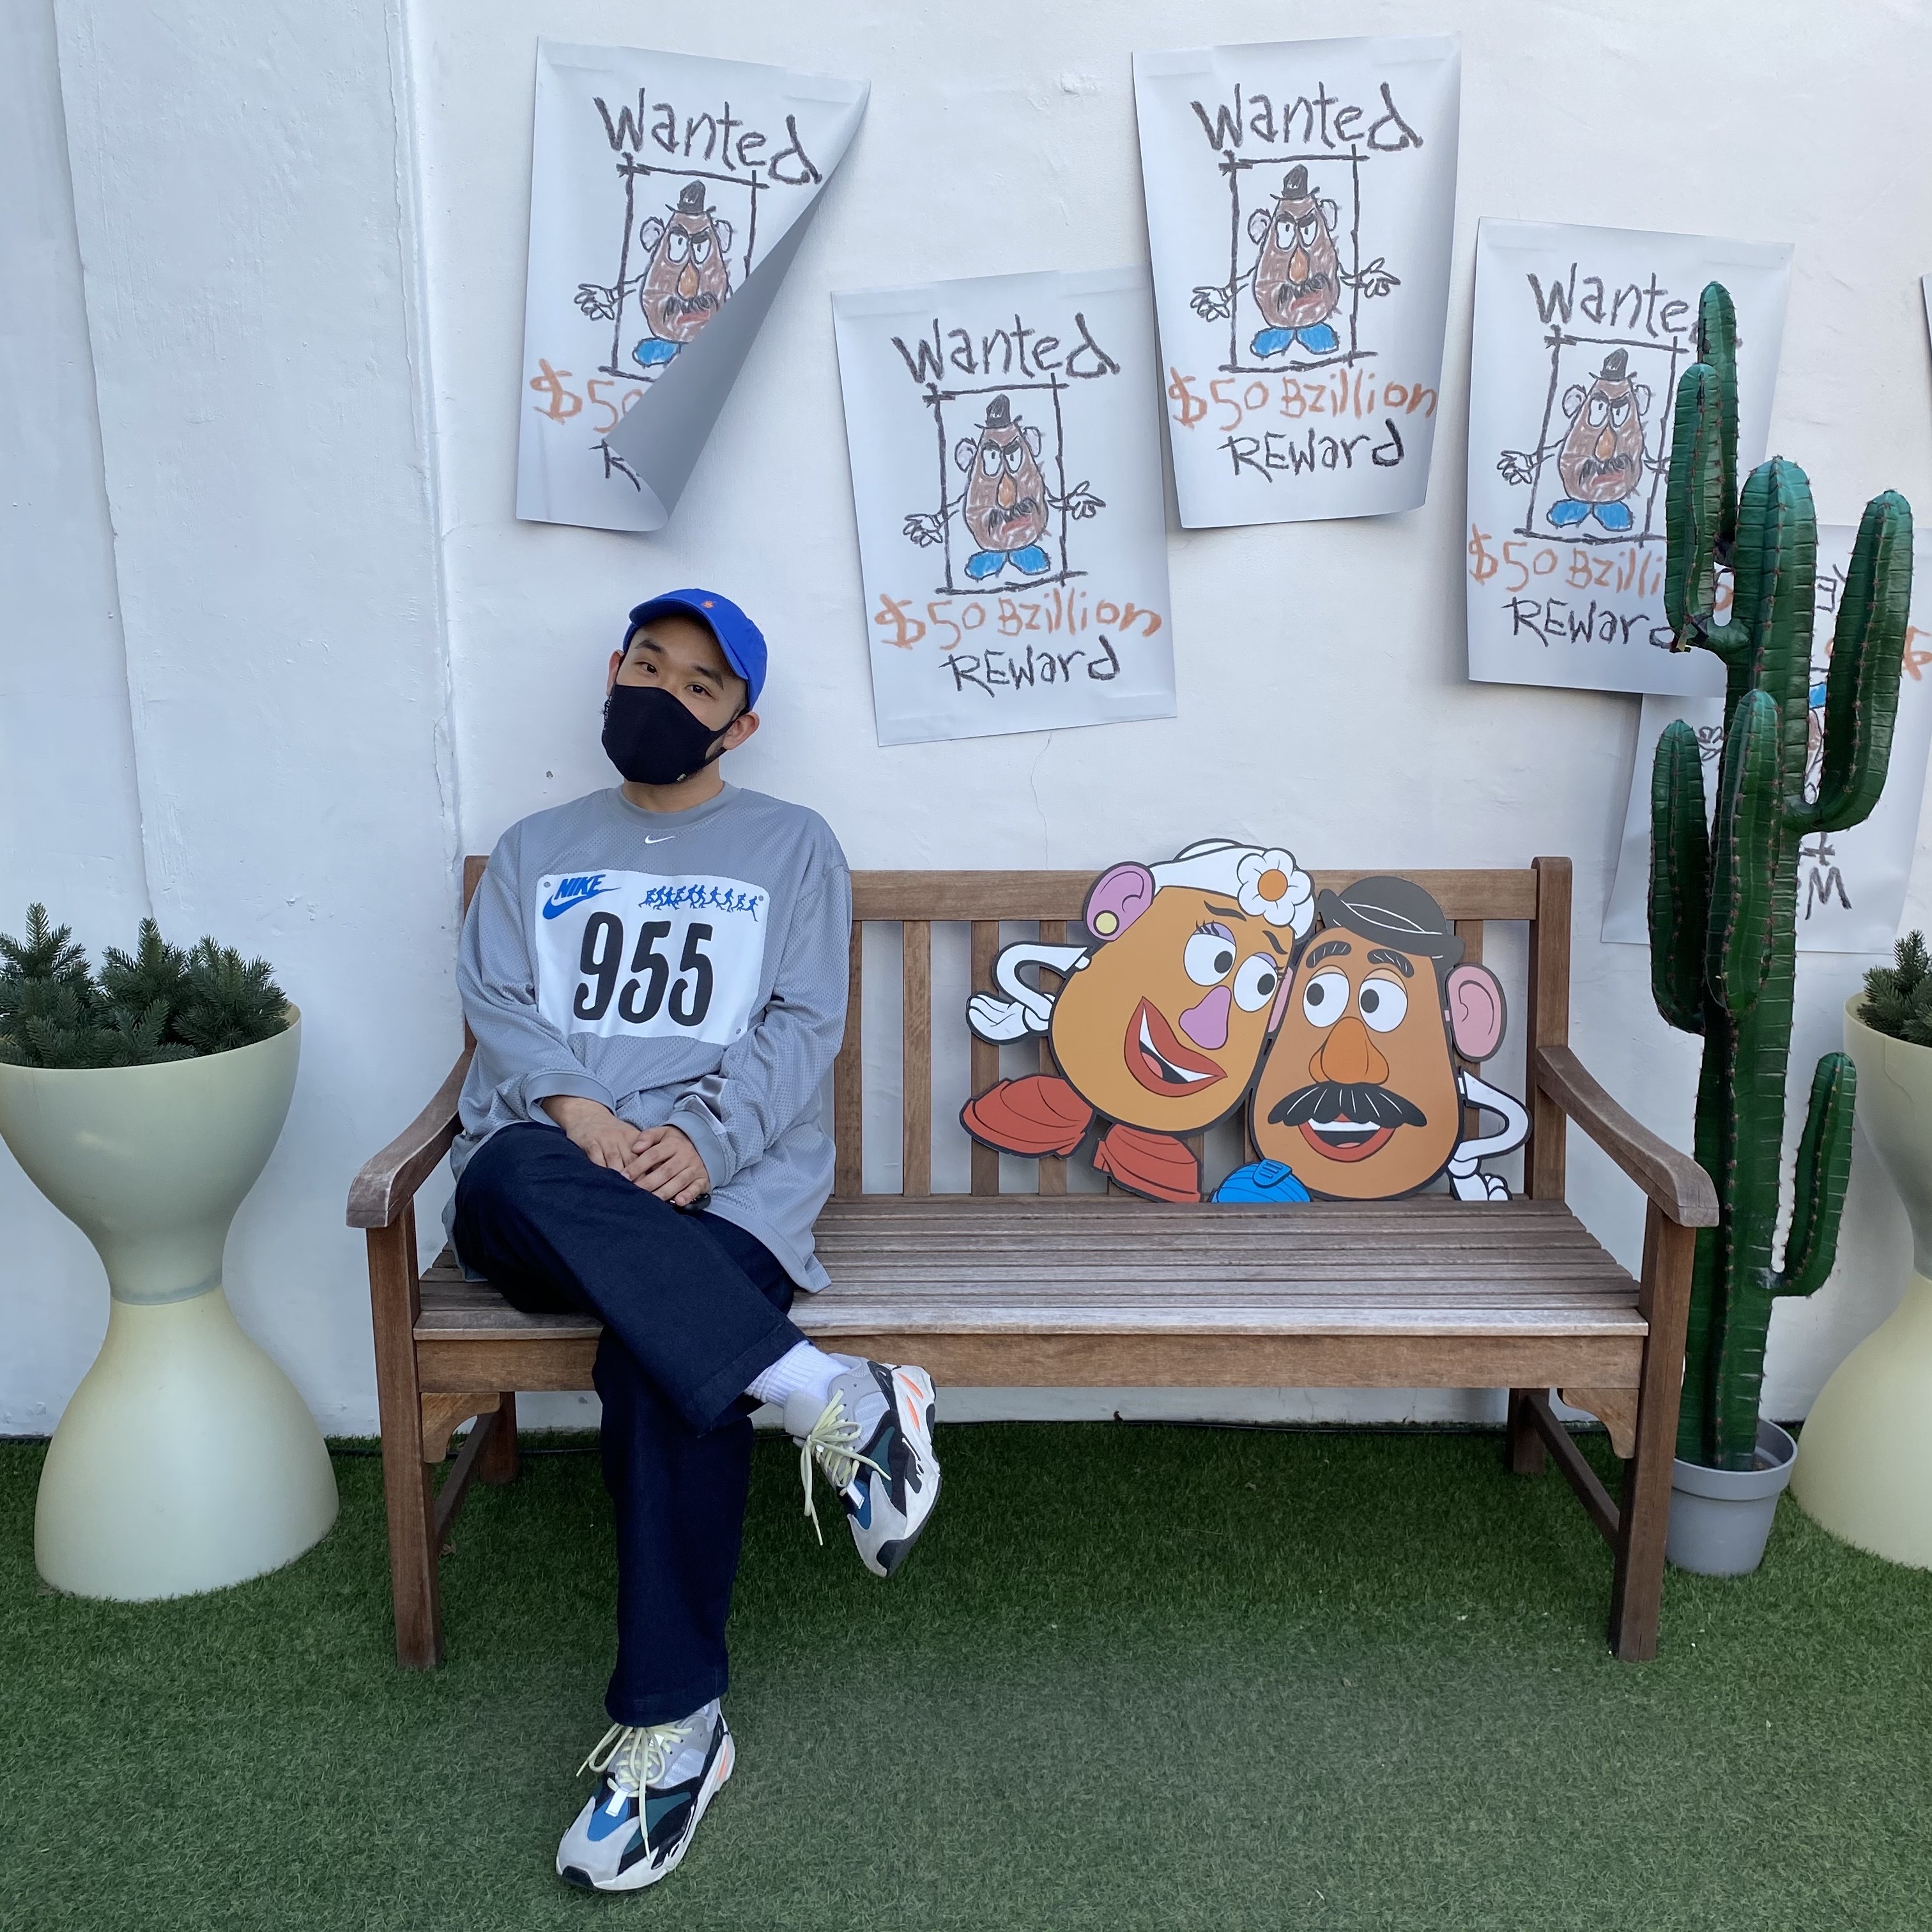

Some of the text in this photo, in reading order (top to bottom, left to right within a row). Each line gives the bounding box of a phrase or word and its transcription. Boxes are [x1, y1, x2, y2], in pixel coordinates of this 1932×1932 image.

[593, 87, 823, 186] Wanted
[1190, 81, 1423, 151] Wanted
[1526, 262, 1743, 346] Wante
[889, 312, 1121, 385] Wanted
[1167, 366, 1436, 433] $50 Bzillion
[1468, 523, 1558, 594] $50
[875, 587, 1163, 651] $50 Bzillion
[554, 874, 606, 900] NIKE
[573, 911, 714, 1027] 955
